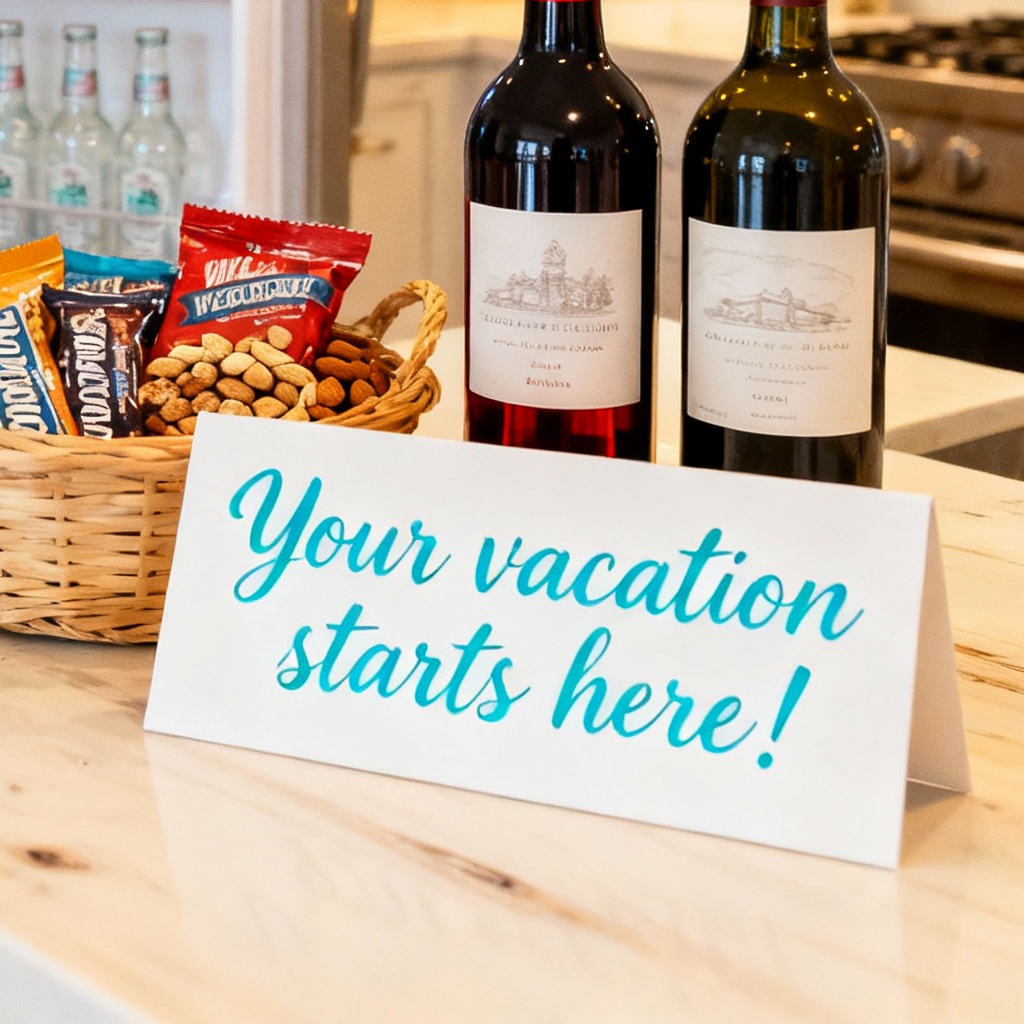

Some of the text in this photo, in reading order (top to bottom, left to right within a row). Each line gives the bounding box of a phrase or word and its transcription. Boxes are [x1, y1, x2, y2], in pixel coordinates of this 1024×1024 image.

[227, 467, 865, 642] Your vacation
[276, 603, 812, 771] starts here!
